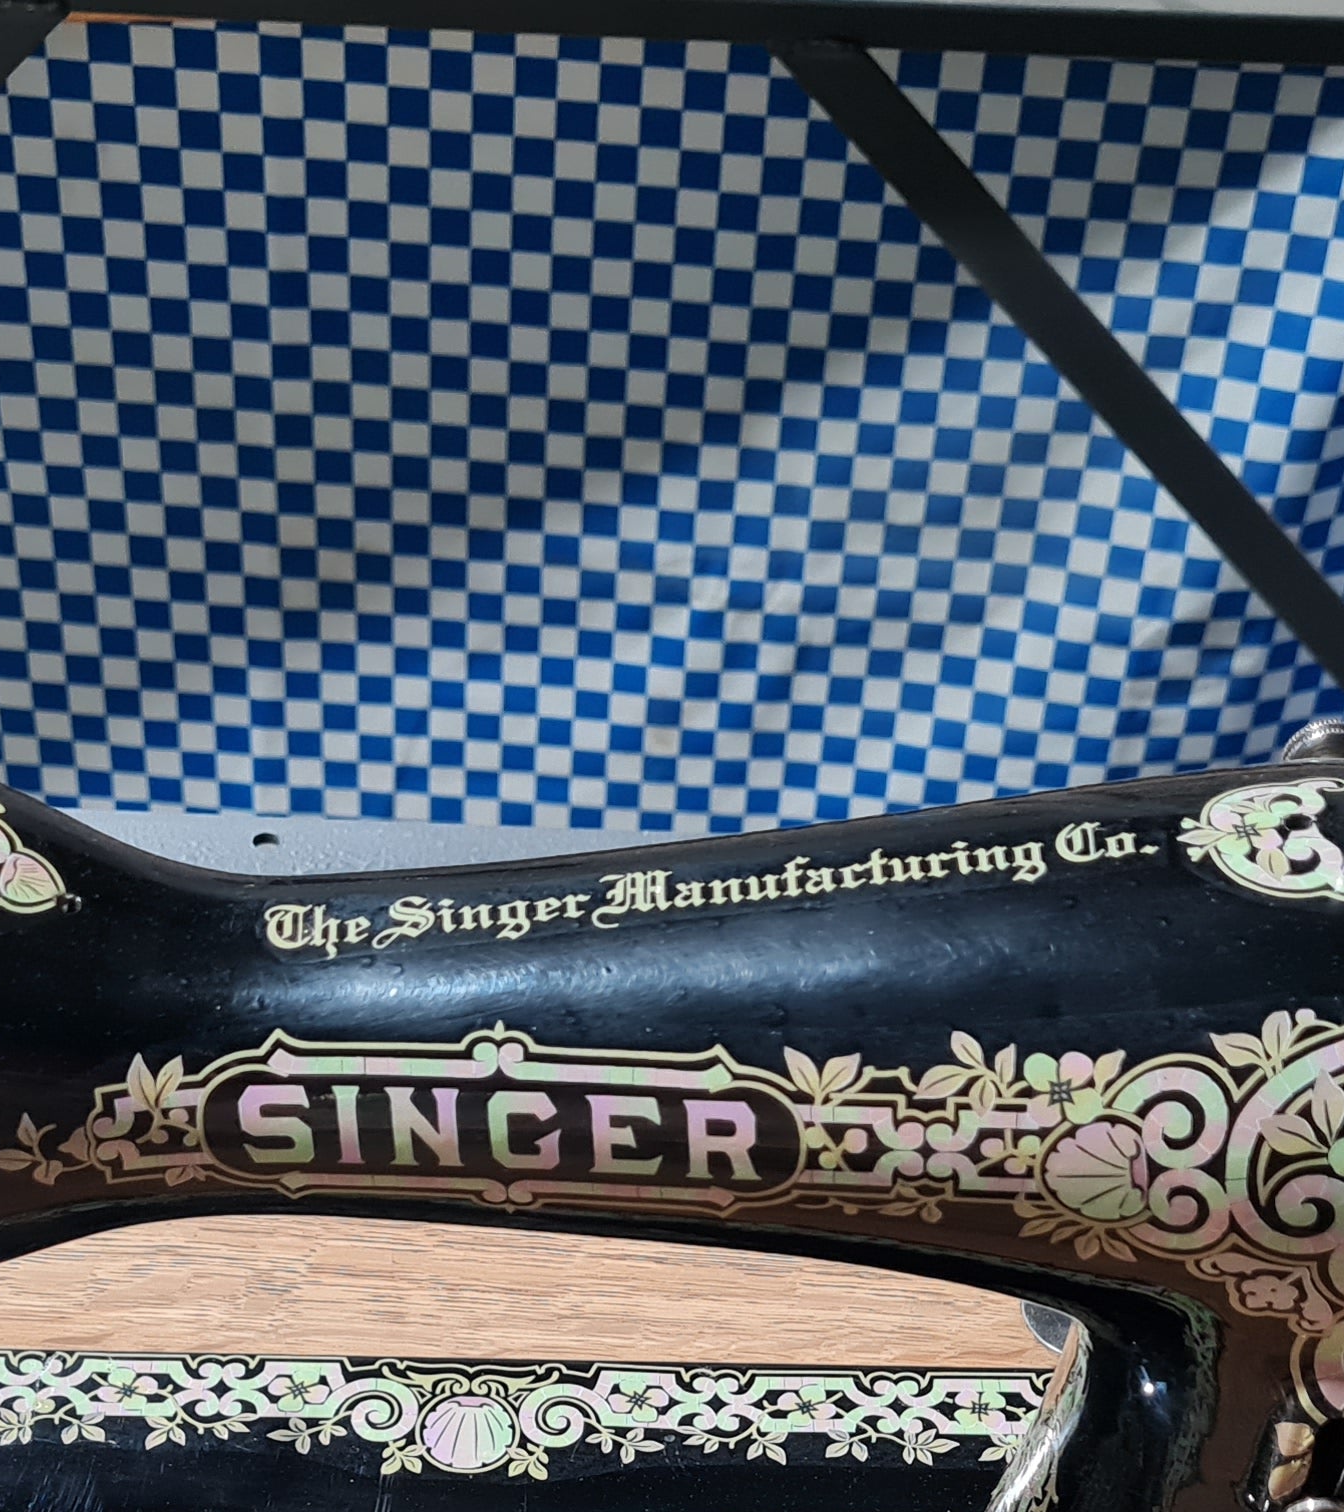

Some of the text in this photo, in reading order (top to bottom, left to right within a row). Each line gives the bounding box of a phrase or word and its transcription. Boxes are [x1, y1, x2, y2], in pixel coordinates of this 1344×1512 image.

[264, 821, 1160, 960] The Singer Manufacturing Co.
[237, 1084, 762, 1182] SINGER
